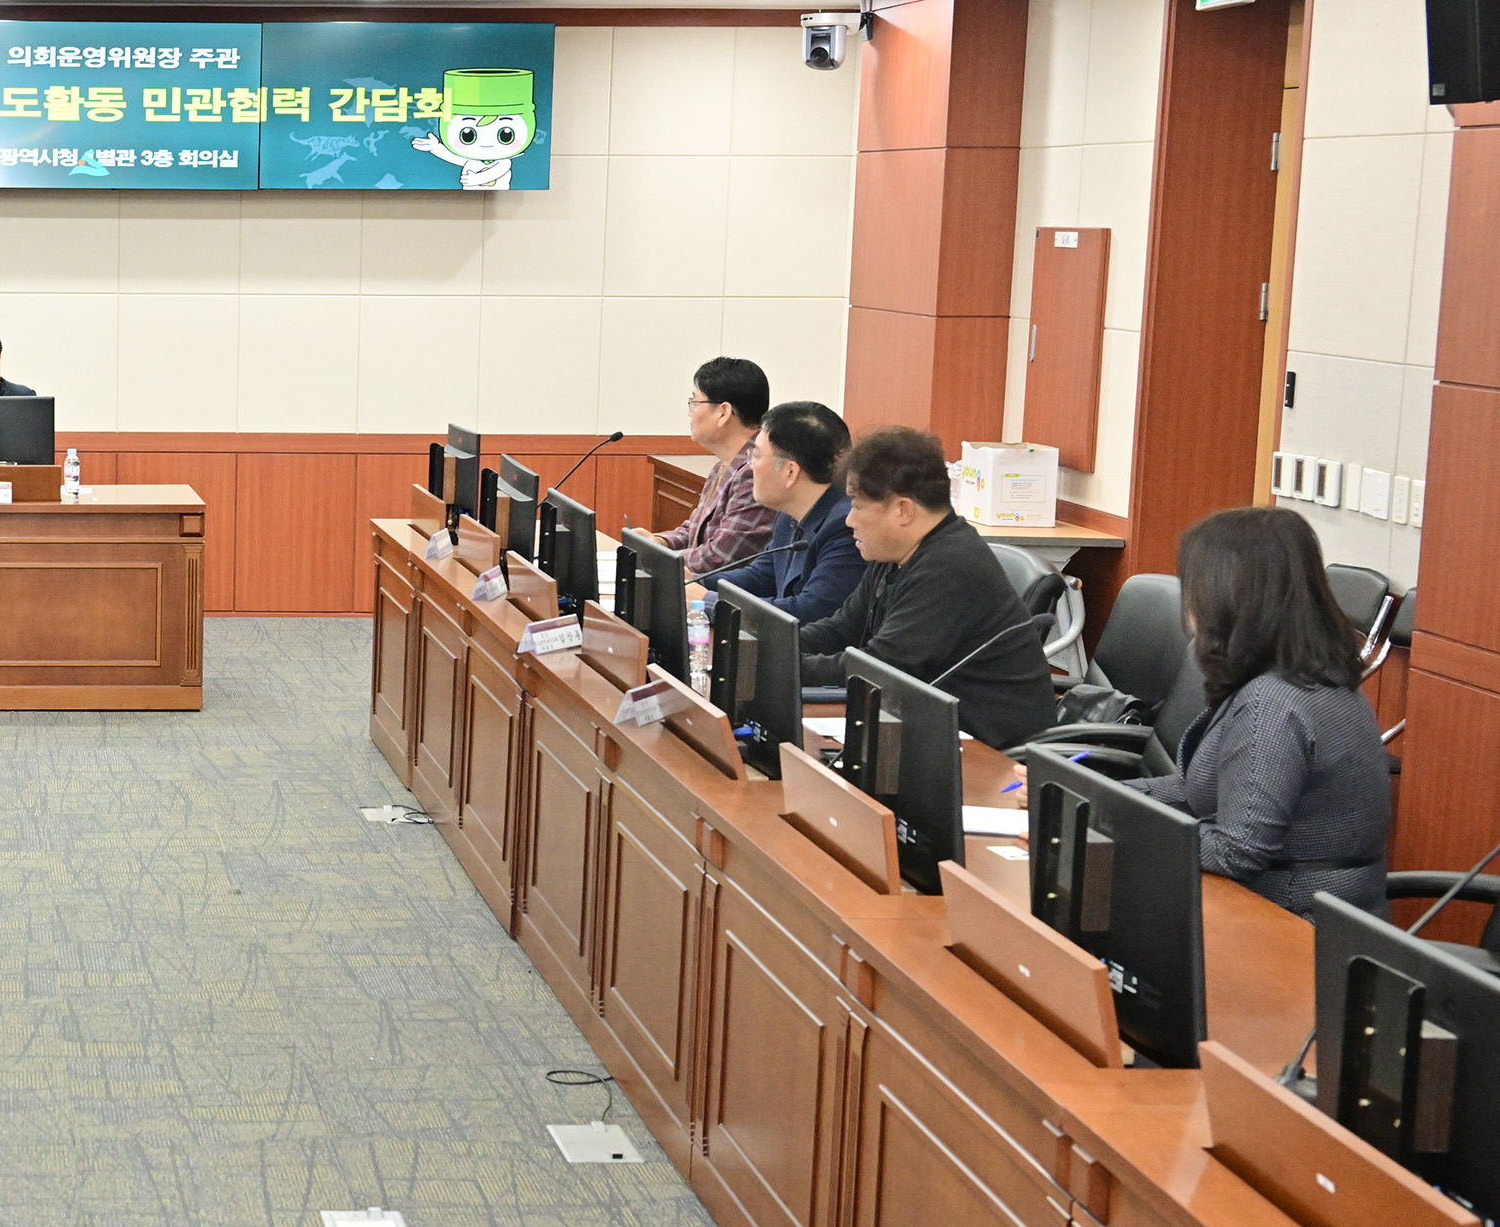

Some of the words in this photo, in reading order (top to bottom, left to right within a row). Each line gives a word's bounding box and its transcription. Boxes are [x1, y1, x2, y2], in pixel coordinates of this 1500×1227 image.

[7, 45, 183, 69] 의회운영위원장
[189, 47, 241, 69] 주관
[143, 86, 312, 124] 민관협력
[328, 86, 453, 124] 간담회
[88, 149, 137, 167] 별관
[140, 149, 174, 168] 3층
[178, 149, 239, 169] 회의실
